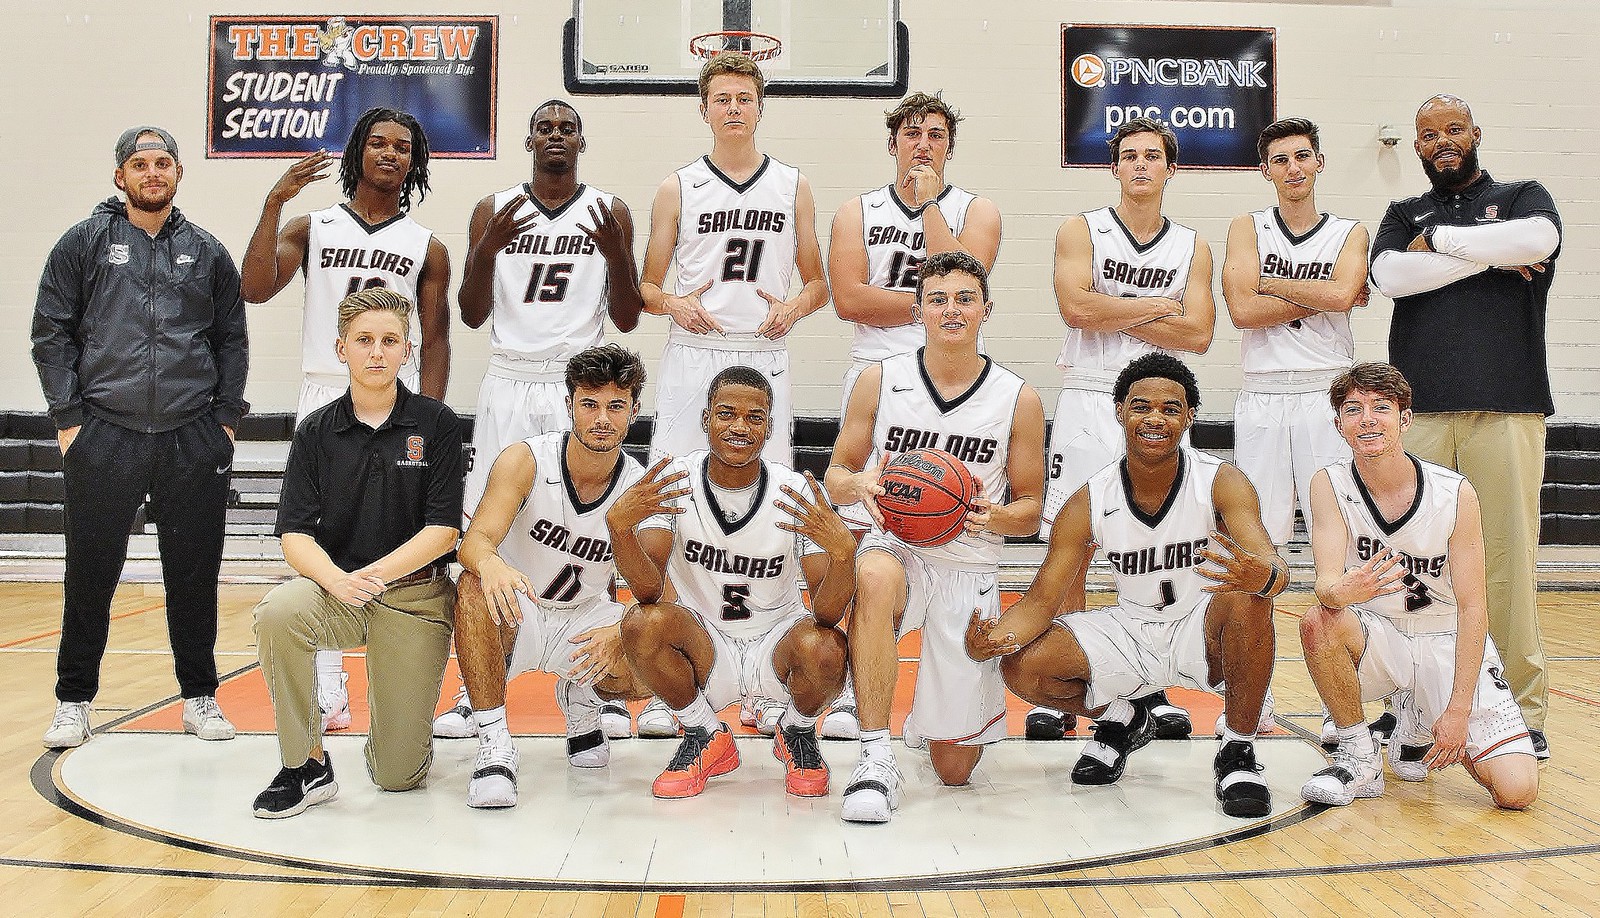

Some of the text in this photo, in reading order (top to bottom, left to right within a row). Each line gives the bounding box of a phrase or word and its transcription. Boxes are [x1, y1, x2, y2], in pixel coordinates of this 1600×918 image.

[228, 25, 479, 61] THE CREW
[358, 62, 398, 76] Proudly
[401, 62, 452, 76] Sponsored
[223, 71, 343, 103] STUDENT
[223, 107, 330, 139] SECTION
[1105, 105, 1235, 133] pnc.com
[697, 208, 786, 234] SAILORS
[505, 234, 596, 256] SAILORS
[721, 237, 766, 283] 21
[320, 247, 415, 278] SAILORS
[523, 262, 575, 303] 15
[407, 435, 424, 461] S
[884, 425, 998, 464] SAILORS
[684, 539, 785, 579] SAILORS
[1107, 537, 1209, 576] SAILORS
[721, 583, 752, 621] 5
